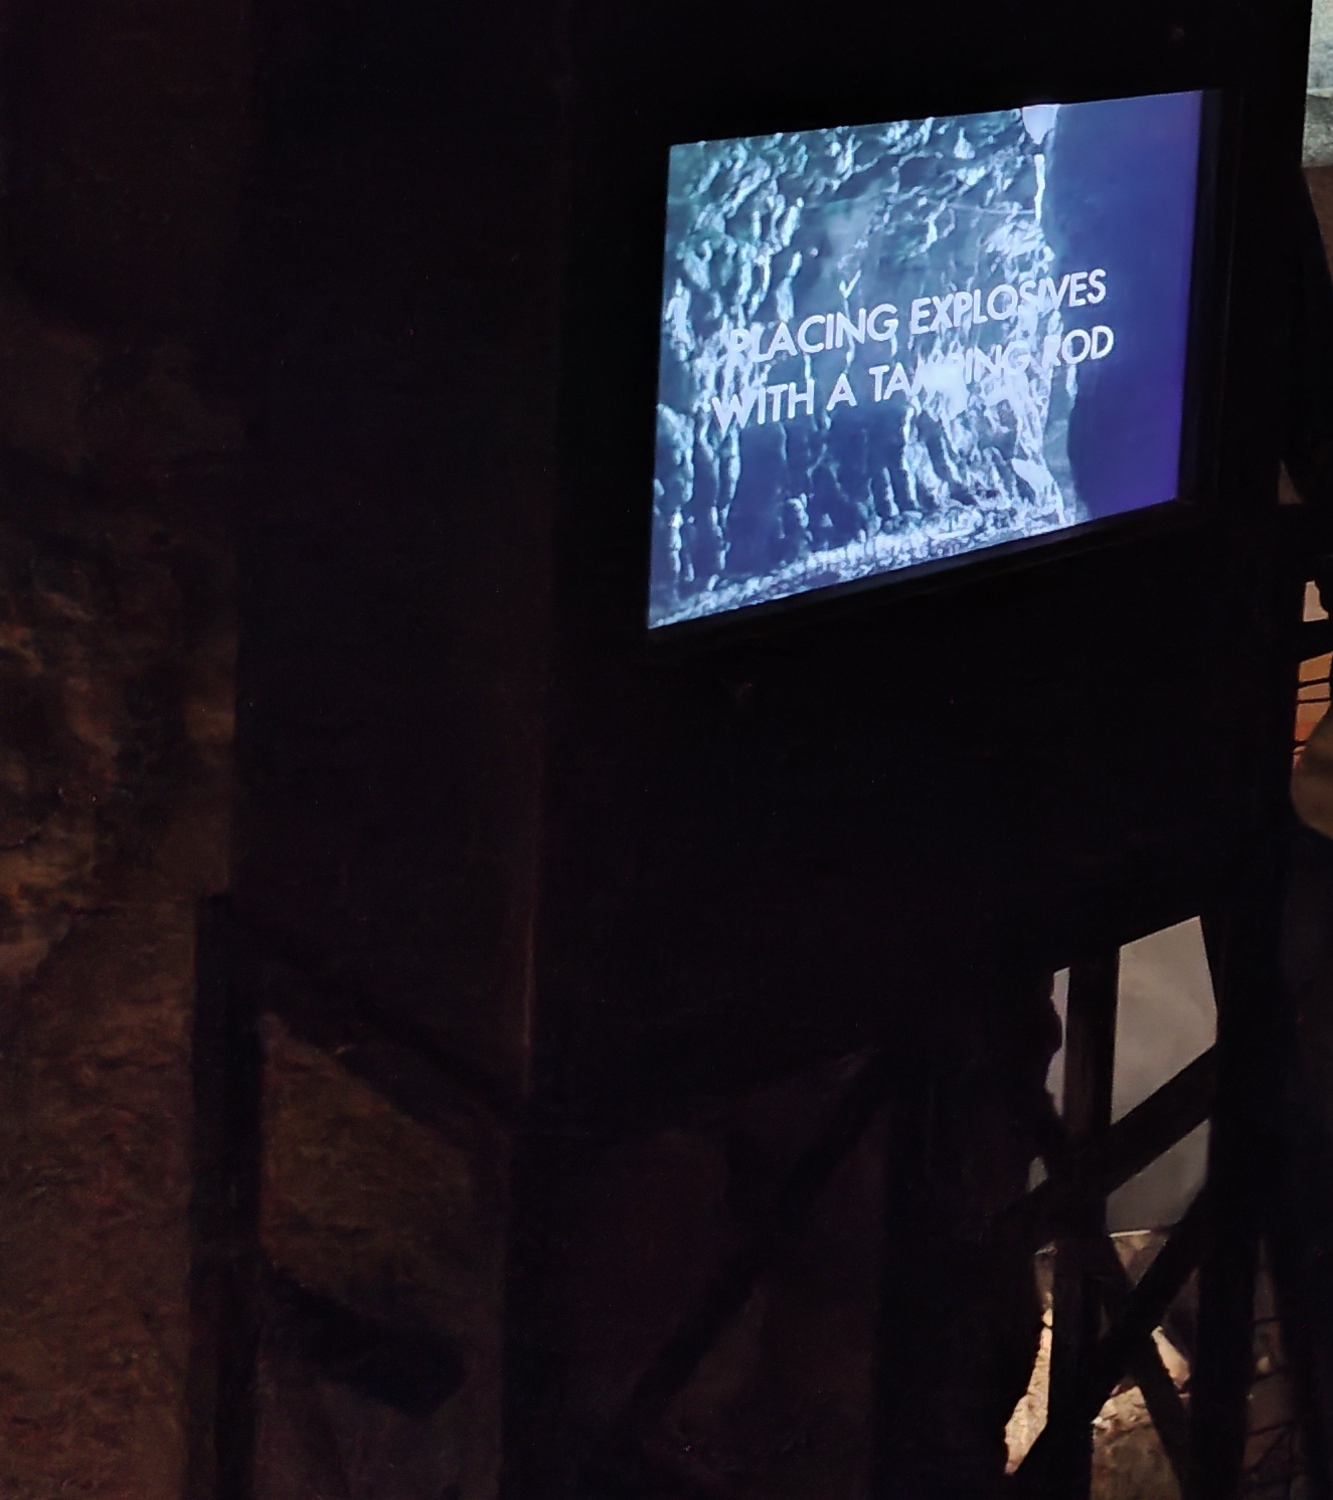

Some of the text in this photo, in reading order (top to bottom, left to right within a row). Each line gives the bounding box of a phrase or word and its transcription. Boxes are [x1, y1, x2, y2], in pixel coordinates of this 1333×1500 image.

[726, 269, 1107, 366] PLACING EXPLOSIVES
[711, 379, 816, 436] WITH
[826, 373, 858, 411] A
[1041, 325, 1114, 369] ROD
